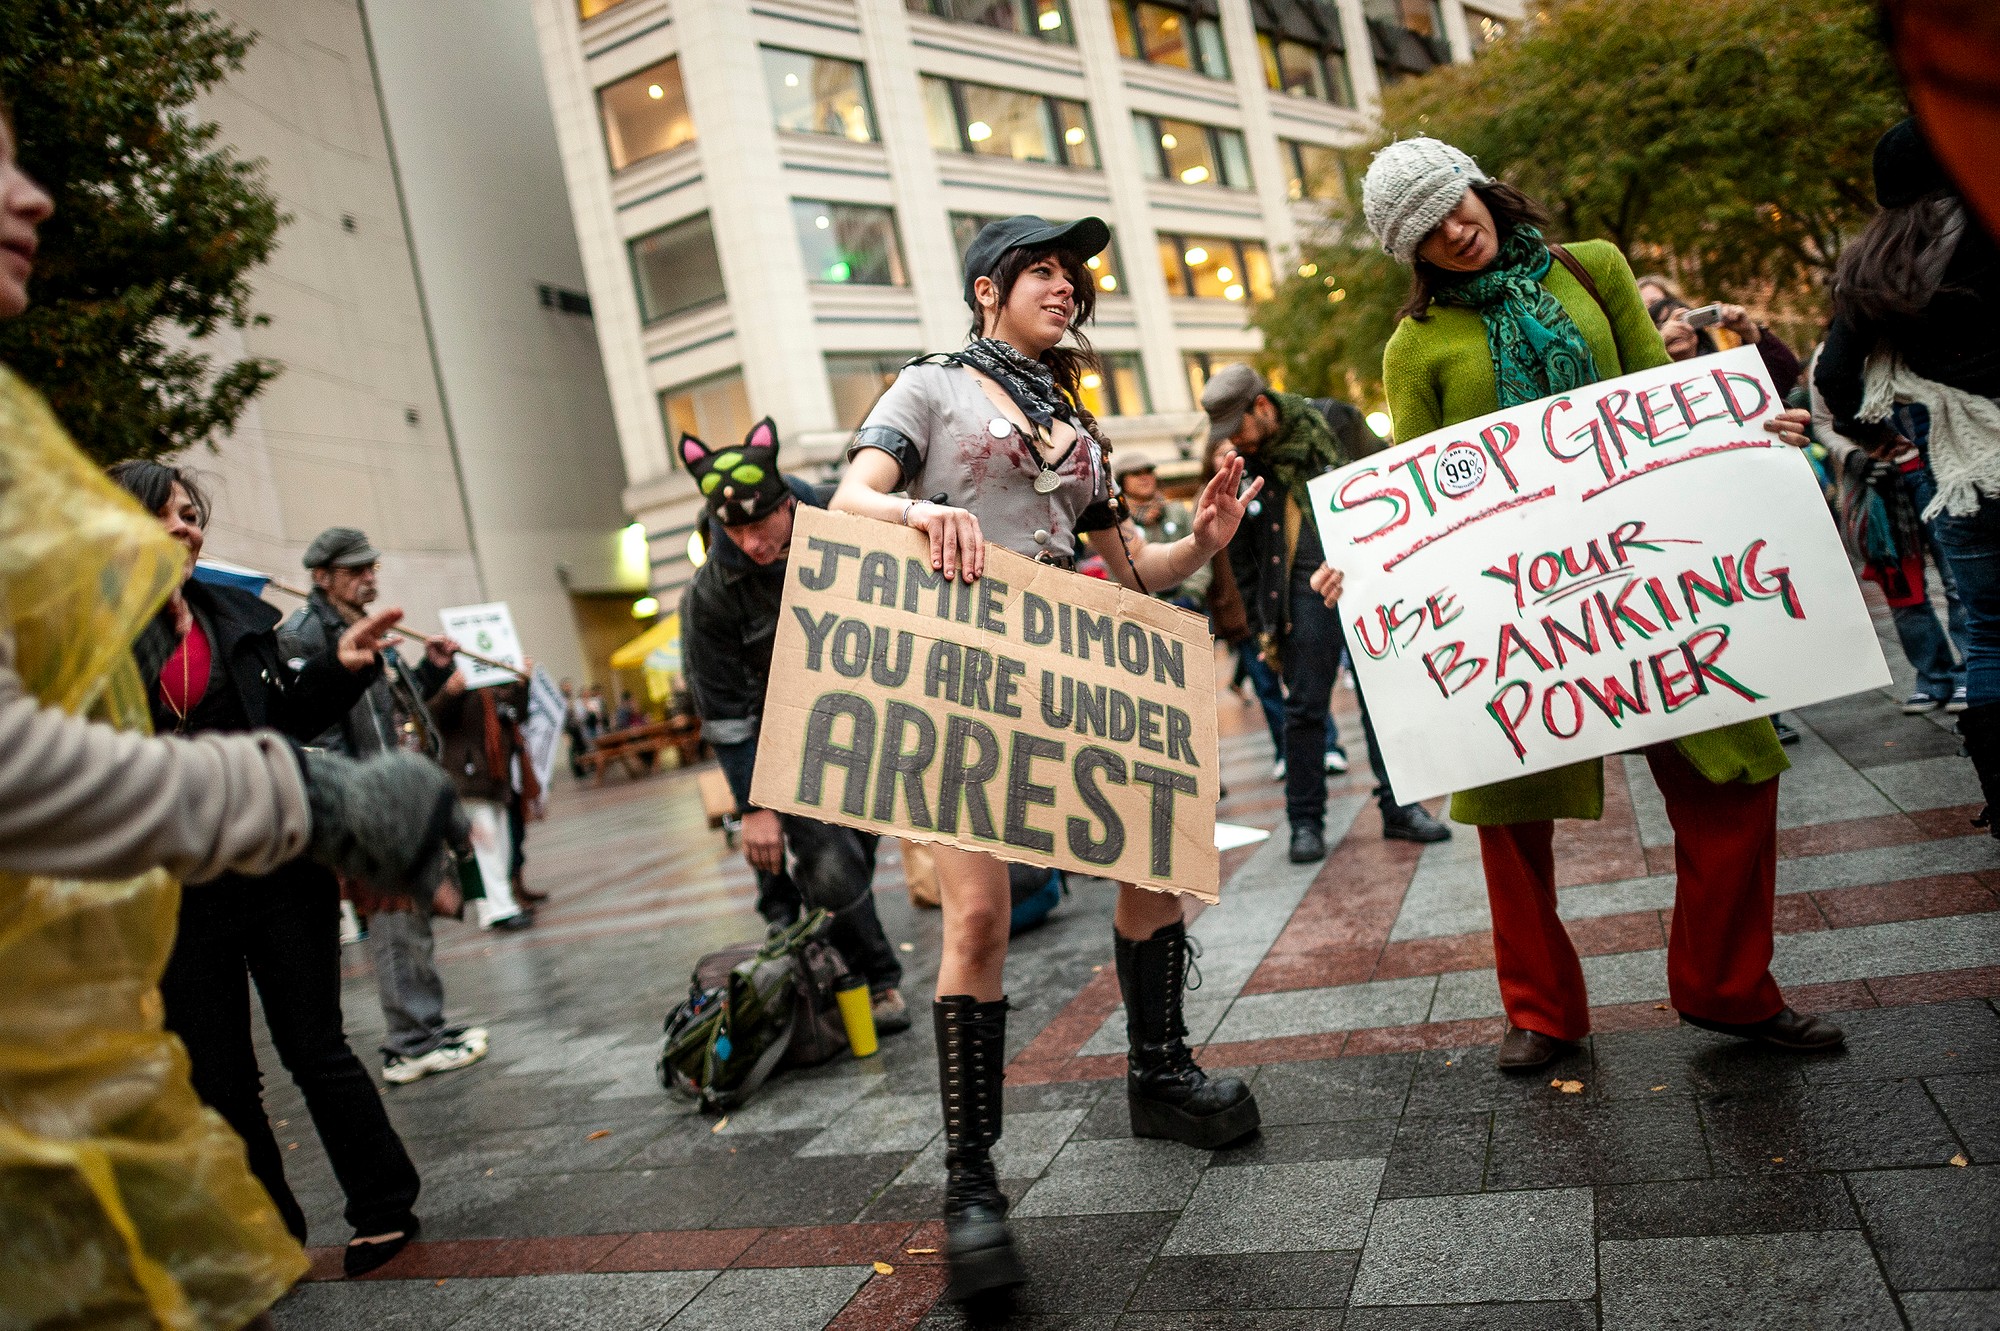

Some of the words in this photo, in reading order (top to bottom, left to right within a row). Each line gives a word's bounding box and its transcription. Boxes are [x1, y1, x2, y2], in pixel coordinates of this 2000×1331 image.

[1329, 420, 1521, 545] STOP
[1540, 368, 1771, 483] GREED
[1446, 458, 1483, 483] 99%
[798, 535, 1009, 636] JAMIE
[1021, 590, 1186, 689] DIMON
[1353, 588, 1464, 660] USE
[1482, 521, 1702, 618] YOUR
[1422, 539, 1806, 699] BANKING
[791, 605, 915, 689] YOU
[925, 639, 1027, 720] ARE
[1040, 670, 1200, 767] UNDER
[1486, 623, 1768, 764] POWER
[795, 690, 1199, 881] ARREST
